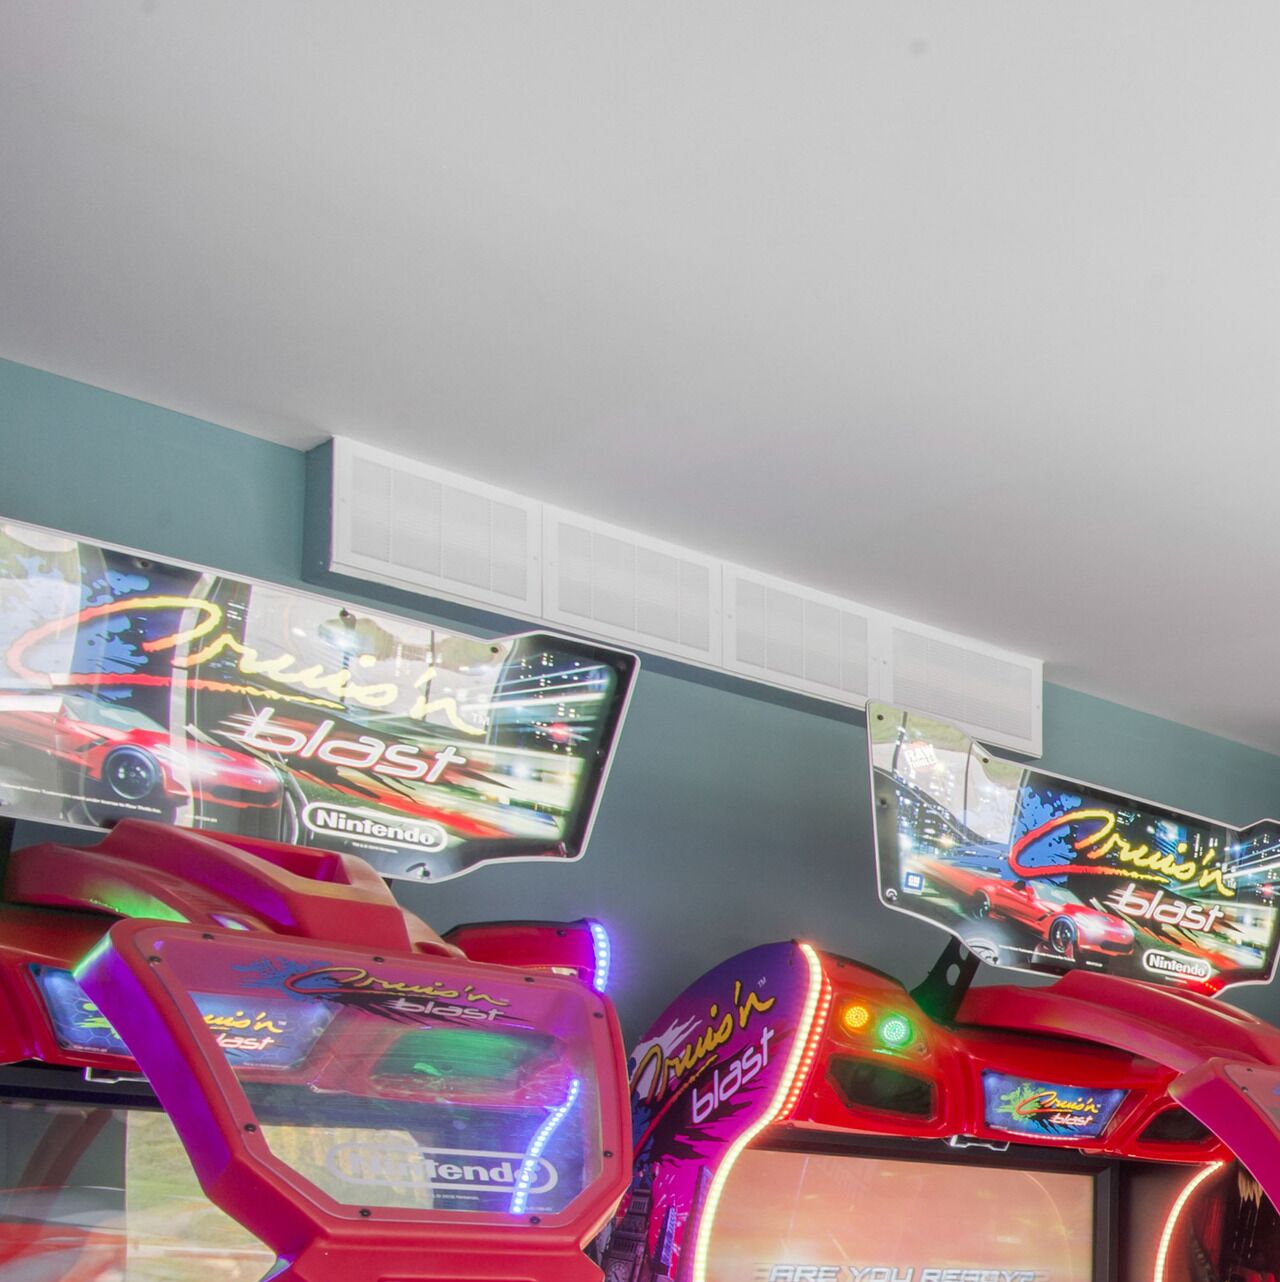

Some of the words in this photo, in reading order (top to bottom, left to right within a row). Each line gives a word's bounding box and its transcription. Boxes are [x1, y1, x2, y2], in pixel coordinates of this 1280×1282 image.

[6, 596, 486, 736] Cruis'n
[243, 707, 466, 783] blast
[316, 809, 435, 845] Nintendo
[1009, 810, 1235, 896] Cruis'n
[1114, 883, 1224, 933] blast
[1149, 955, 1205, 976] Nintendo
[203, 1010, 283, 1033] uis'n
[394, 998, 504, 1020] blast
[216, 1033, 274, 1050] last
[692, 1027, 774, 1123] blast
[349, 1151, 537, 1183] Nintendo
